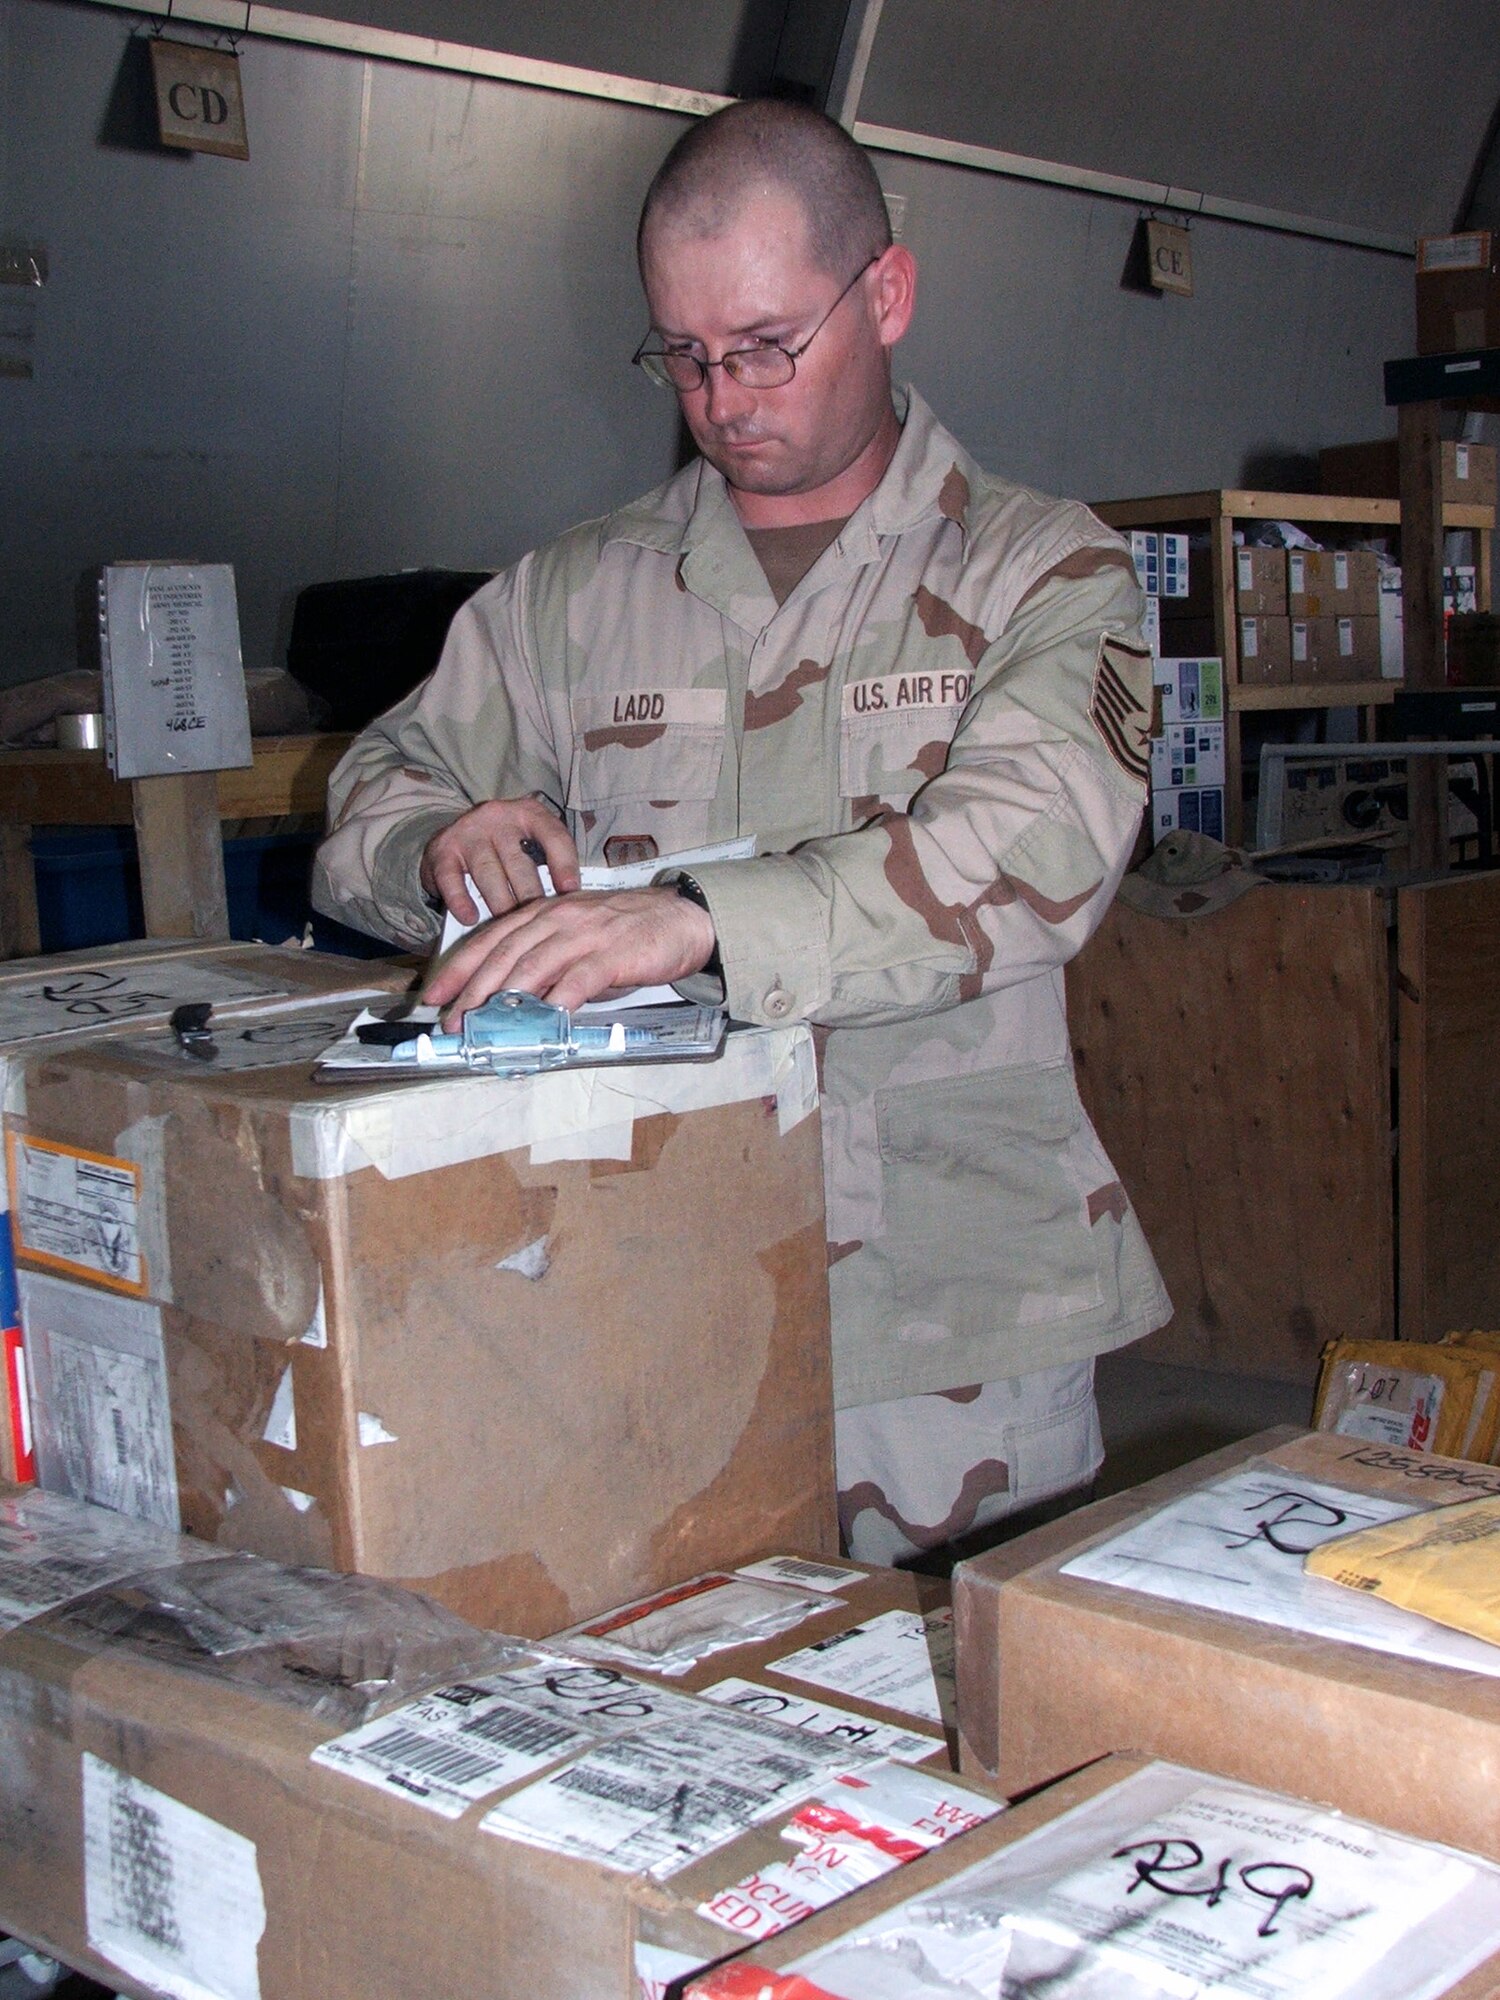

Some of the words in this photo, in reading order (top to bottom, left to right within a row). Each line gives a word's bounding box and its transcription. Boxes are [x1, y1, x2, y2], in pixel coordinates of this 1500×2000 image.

[169, 83, 228, 124] CD
[1157, 247, 1183, 275] CE
[613, 693, 665, 723] LADD
[853, 682, 888, 712] U.S.
[896, 674, 933, 707] AIR
[405, 1701, 448, 1723] TAS
[1219, 1817, 1305, 1846] AGENCY
[1284, 1822, 1379, 1860] DEFENSE
[1110, 1838, 1315, 1938] R19
